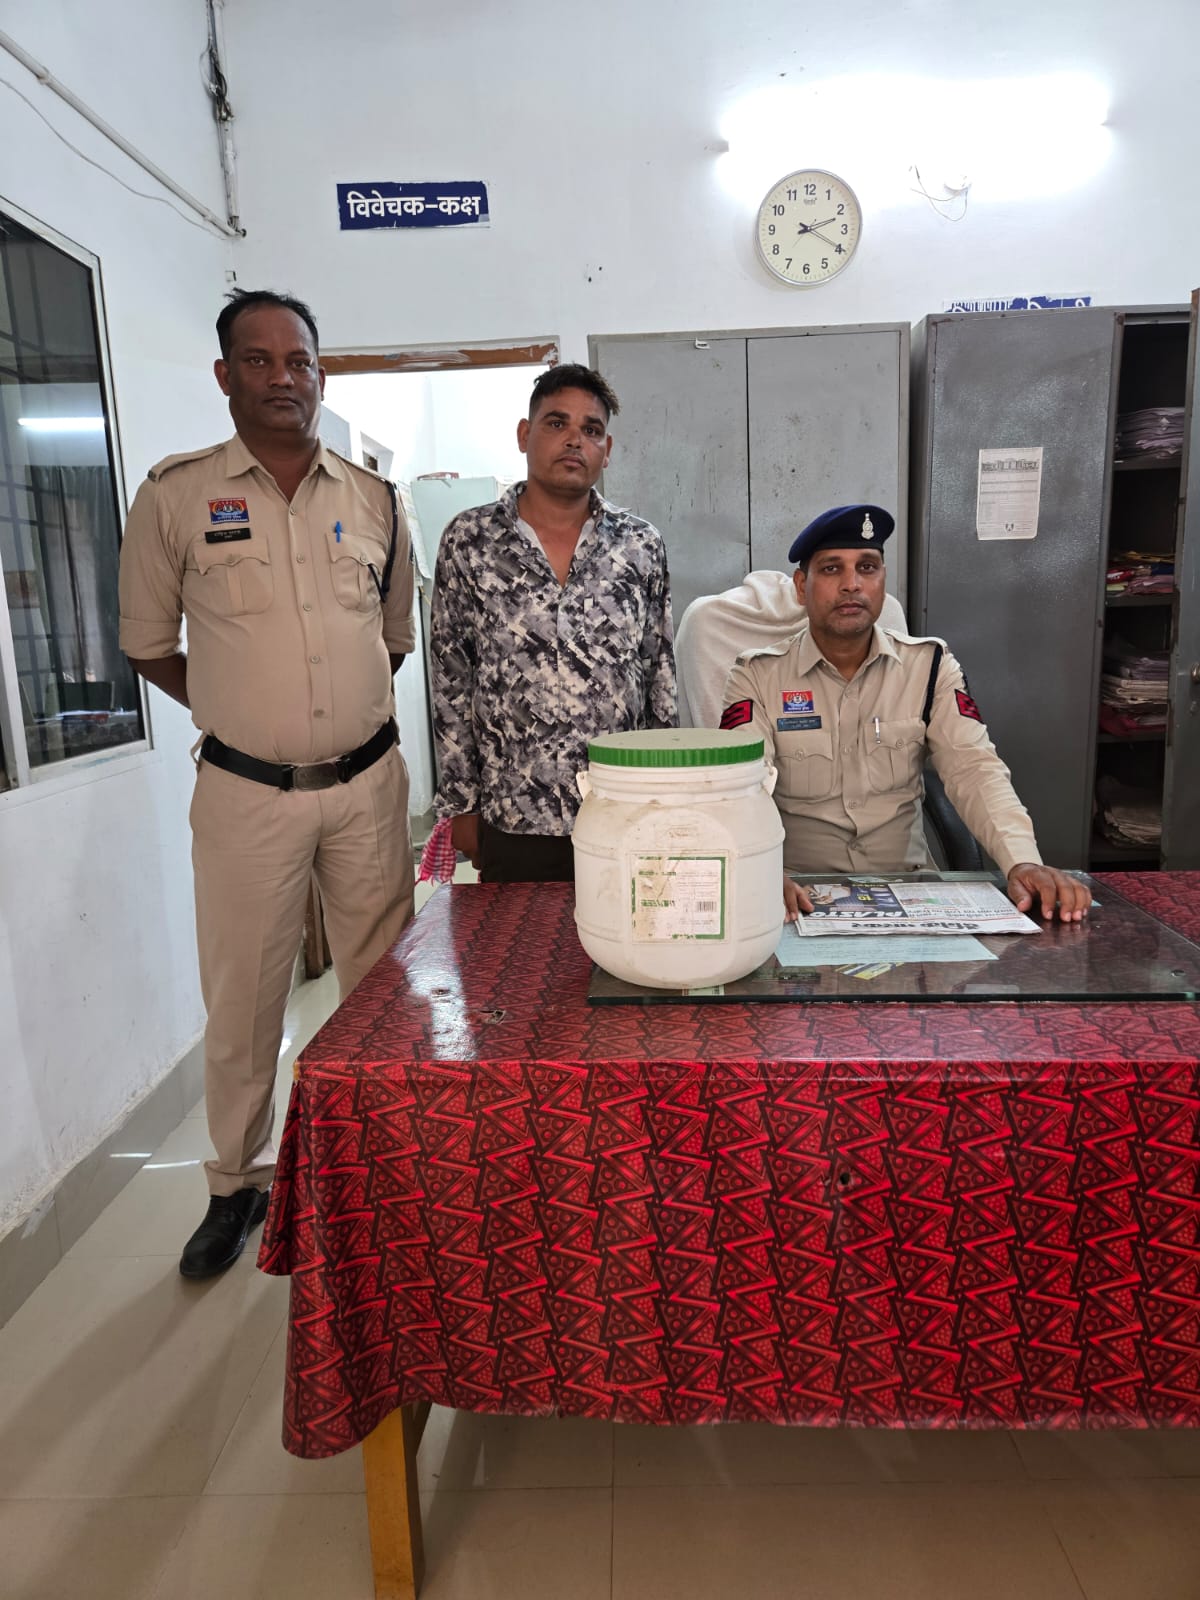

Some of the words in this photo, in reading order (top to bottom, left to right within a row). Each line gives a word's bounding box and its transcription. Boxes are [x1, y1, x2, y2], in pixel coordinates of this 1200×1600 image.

[786, 189, 797, 201] 11
[804, 183, 816, 195] 12
[825, 189, 831, 200] 1
[347, 190, 481, 218] विवेचक-कक्ष
[772, 204, 785, 216] 10
[837, 203, 845, 215] 2
[768, 224, 776, 236] 9
[840, 224, 848, 235] 3
[772, 244, 780, 255] 8
[834, 243, 843, 255] 4
[785, 258, 793, 270] 7
[802, 263, 810, 274] 6
[821, 258, 829, 269] 5
